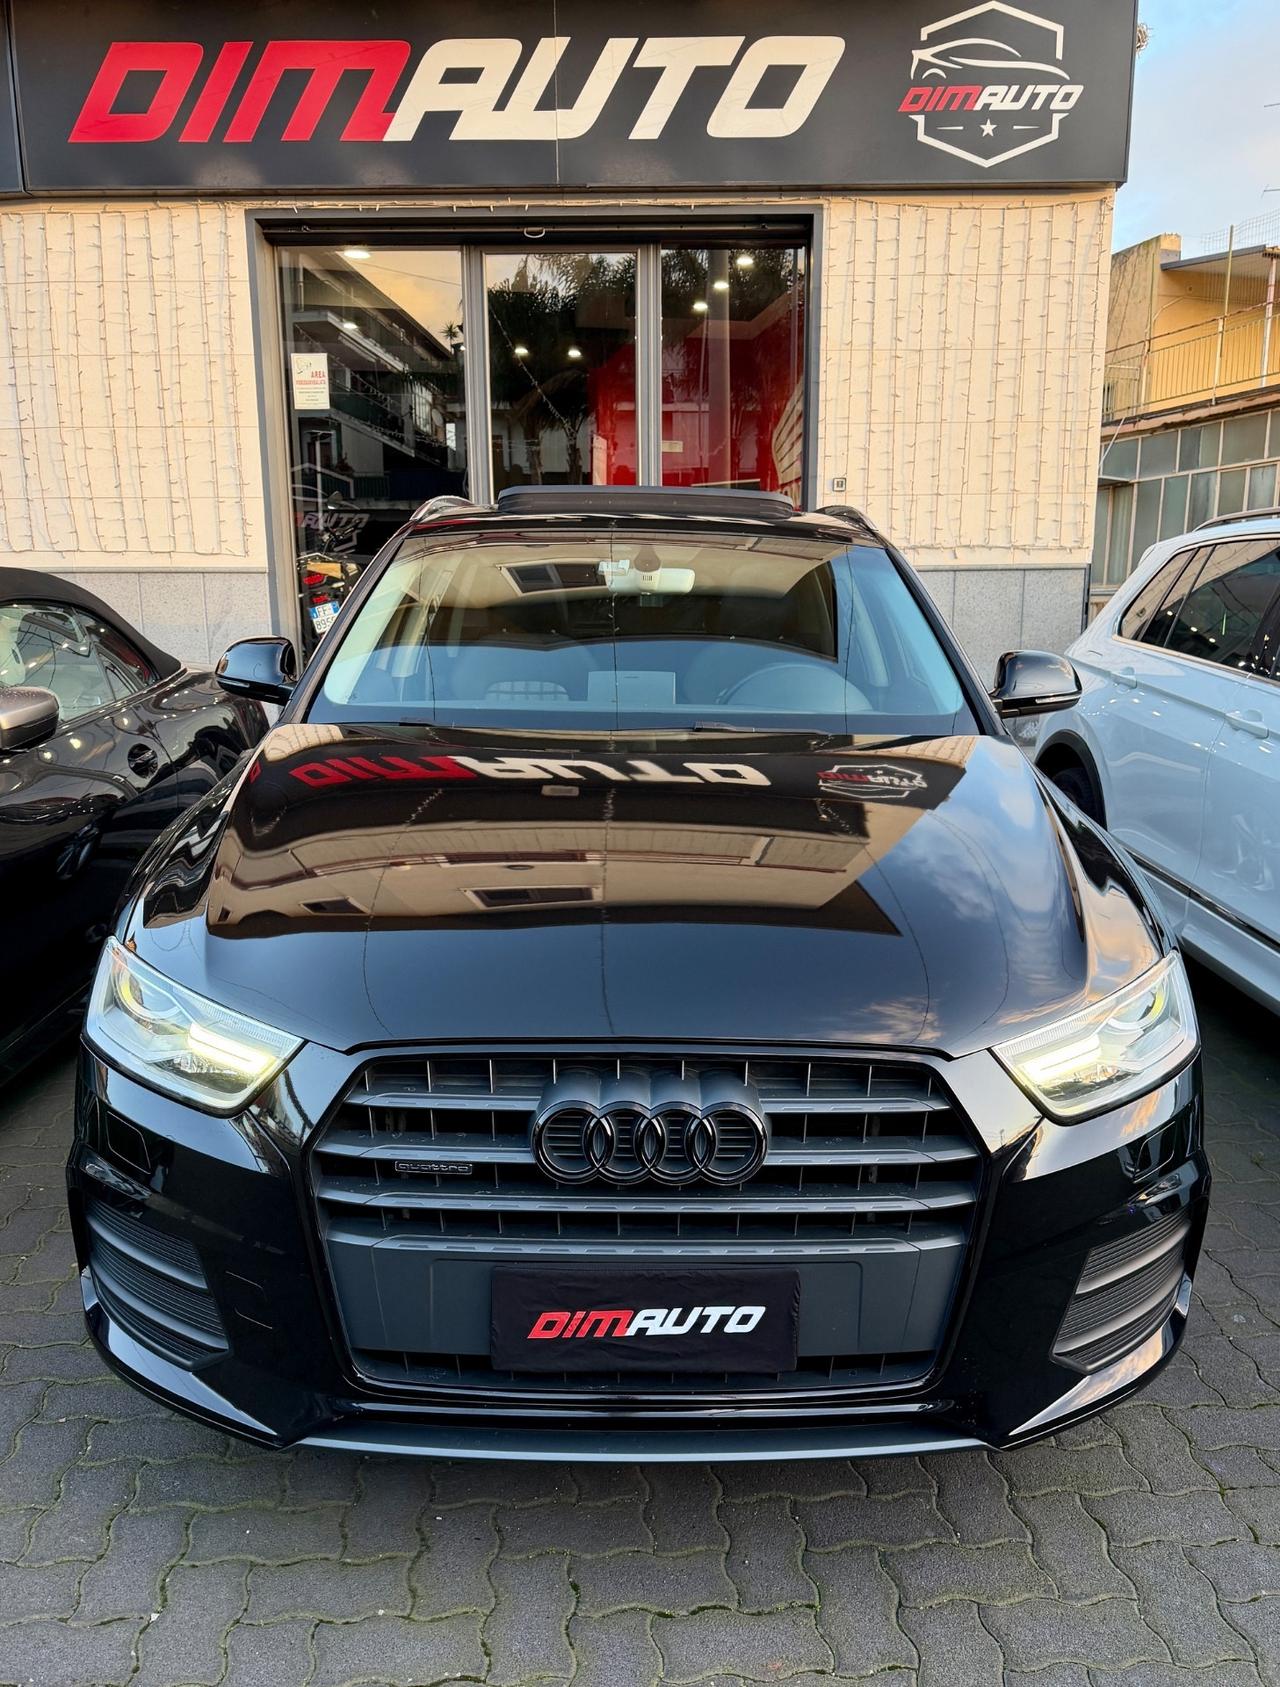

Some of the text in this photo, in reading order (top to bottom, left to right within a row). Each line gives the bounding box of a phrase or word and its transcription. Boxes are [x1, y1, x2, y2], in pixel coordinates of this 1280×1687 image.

[68, 35, 845, 143] DIMAUTO
[898, 84, 1084, 112] DIMAUTO
[398, 1163, 470, 1173] quattro
[527, 1306, 766, 1339] DIMAUTO
